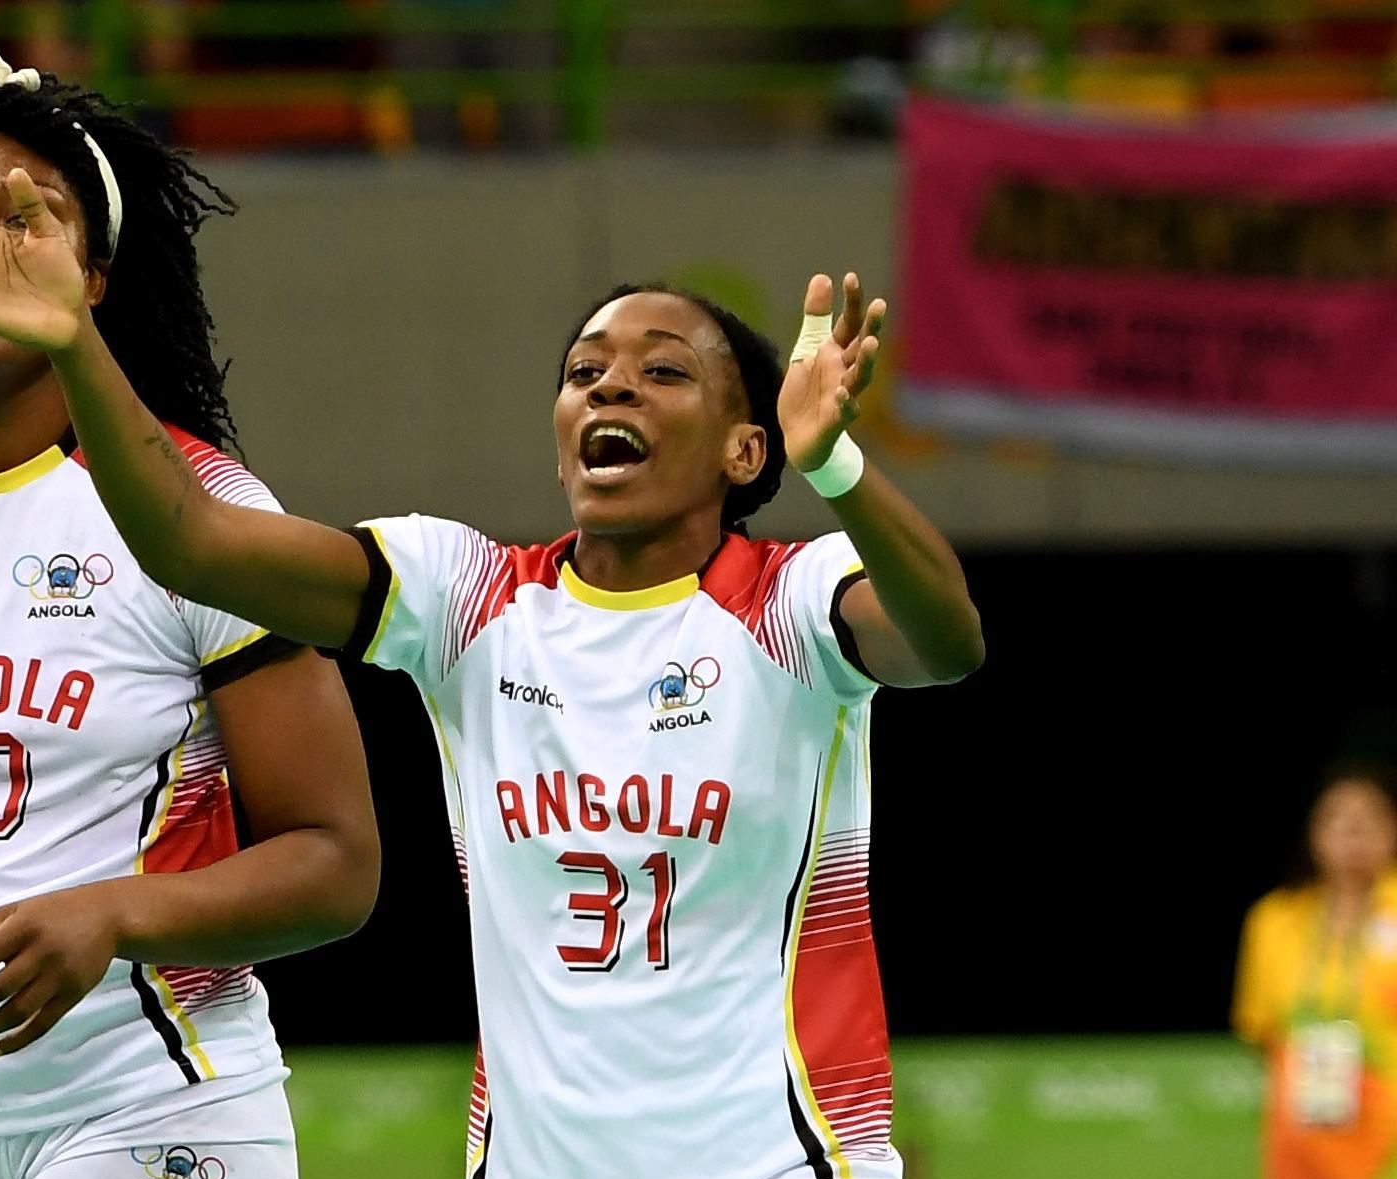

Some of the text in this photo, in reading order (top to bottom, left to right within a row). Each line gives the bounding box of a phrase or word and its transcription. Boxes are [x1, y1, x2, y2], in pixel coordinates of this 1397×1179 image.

[27, 604, 96, 620] ANGOLA
[648, 709, 713, 734] ANGOLA
[495, 770, 731, 845] ANGOLA
[555, 850, 677, 973] 31
